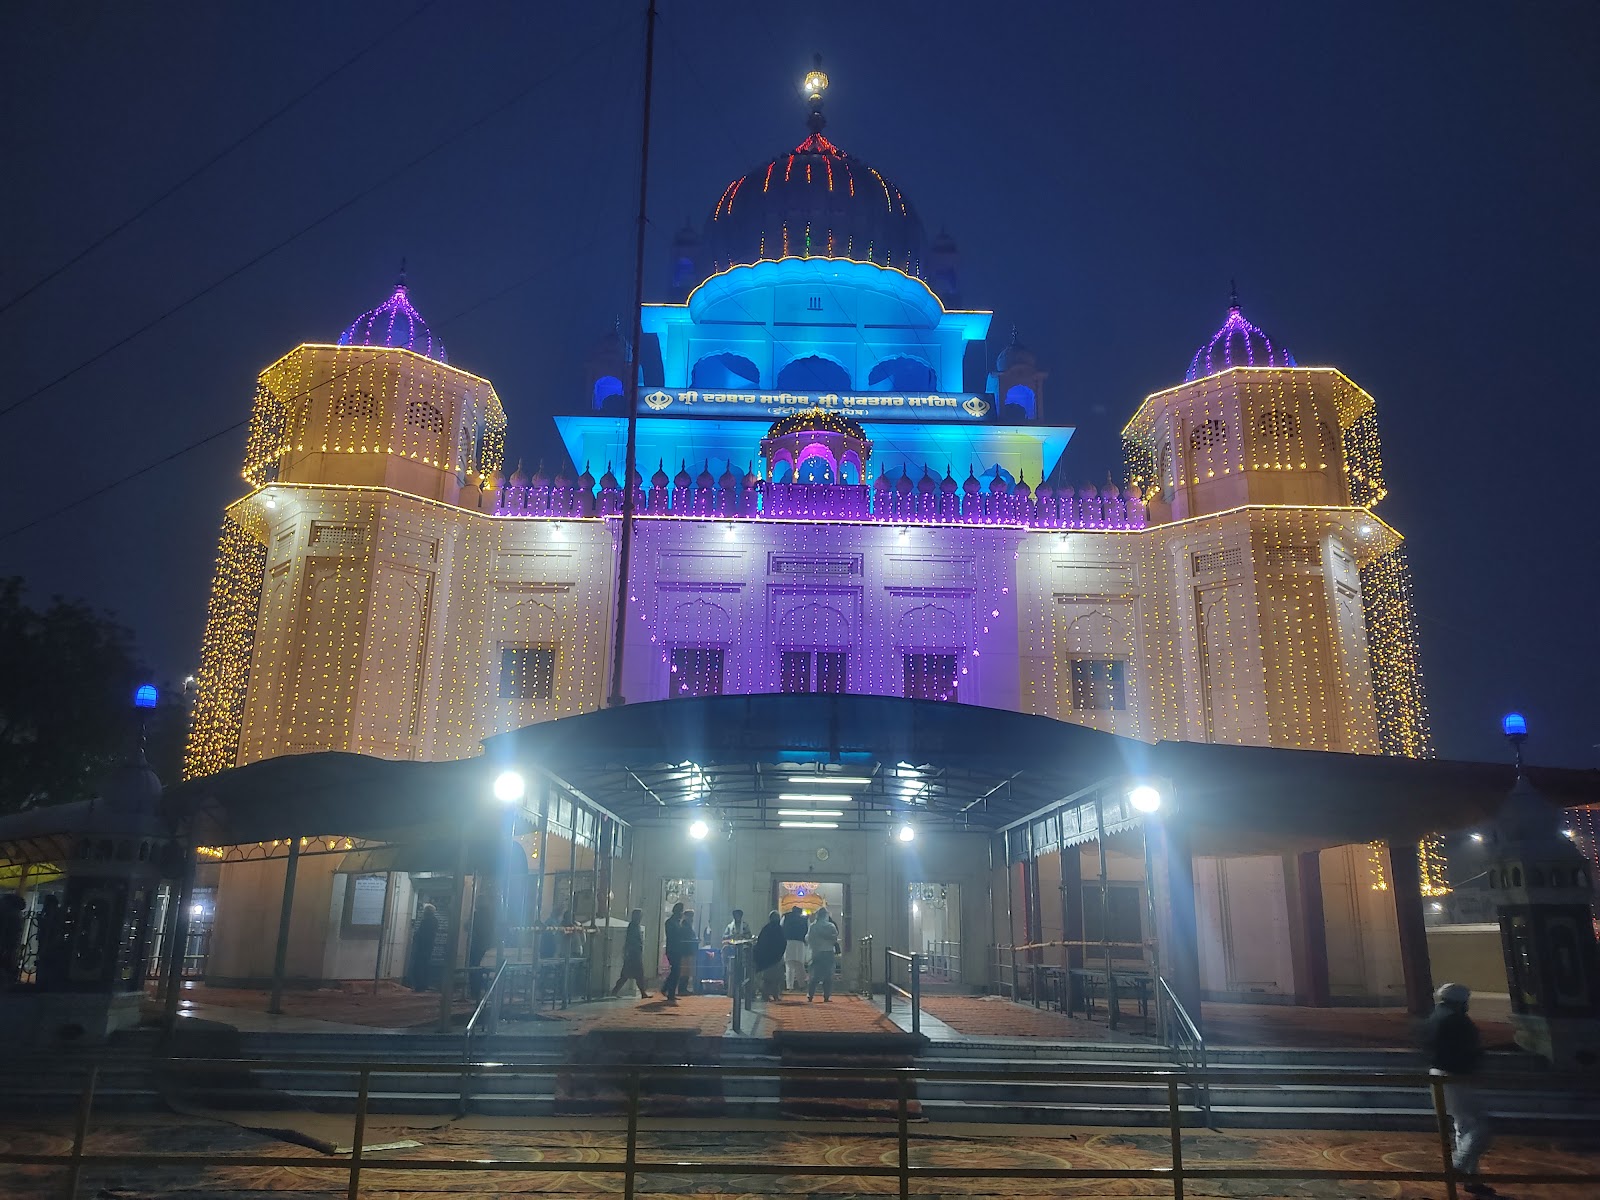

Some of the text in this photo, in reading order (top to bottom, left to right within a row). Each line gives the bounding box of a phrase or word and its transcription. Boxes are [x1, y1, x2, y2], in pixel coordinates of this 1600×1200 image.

[678, 391, 698, 405] ਸ੍ਰੀ
[702, 393, 756, 403] ਦਰਬਾਰ
[818, 394, 838, 408] ਸ੍ਰੀ
[842, 396, 904, 408] ਮੁਕਤਸਰ
[908, 395, 957, 407] ਸਾਹਿਬ
